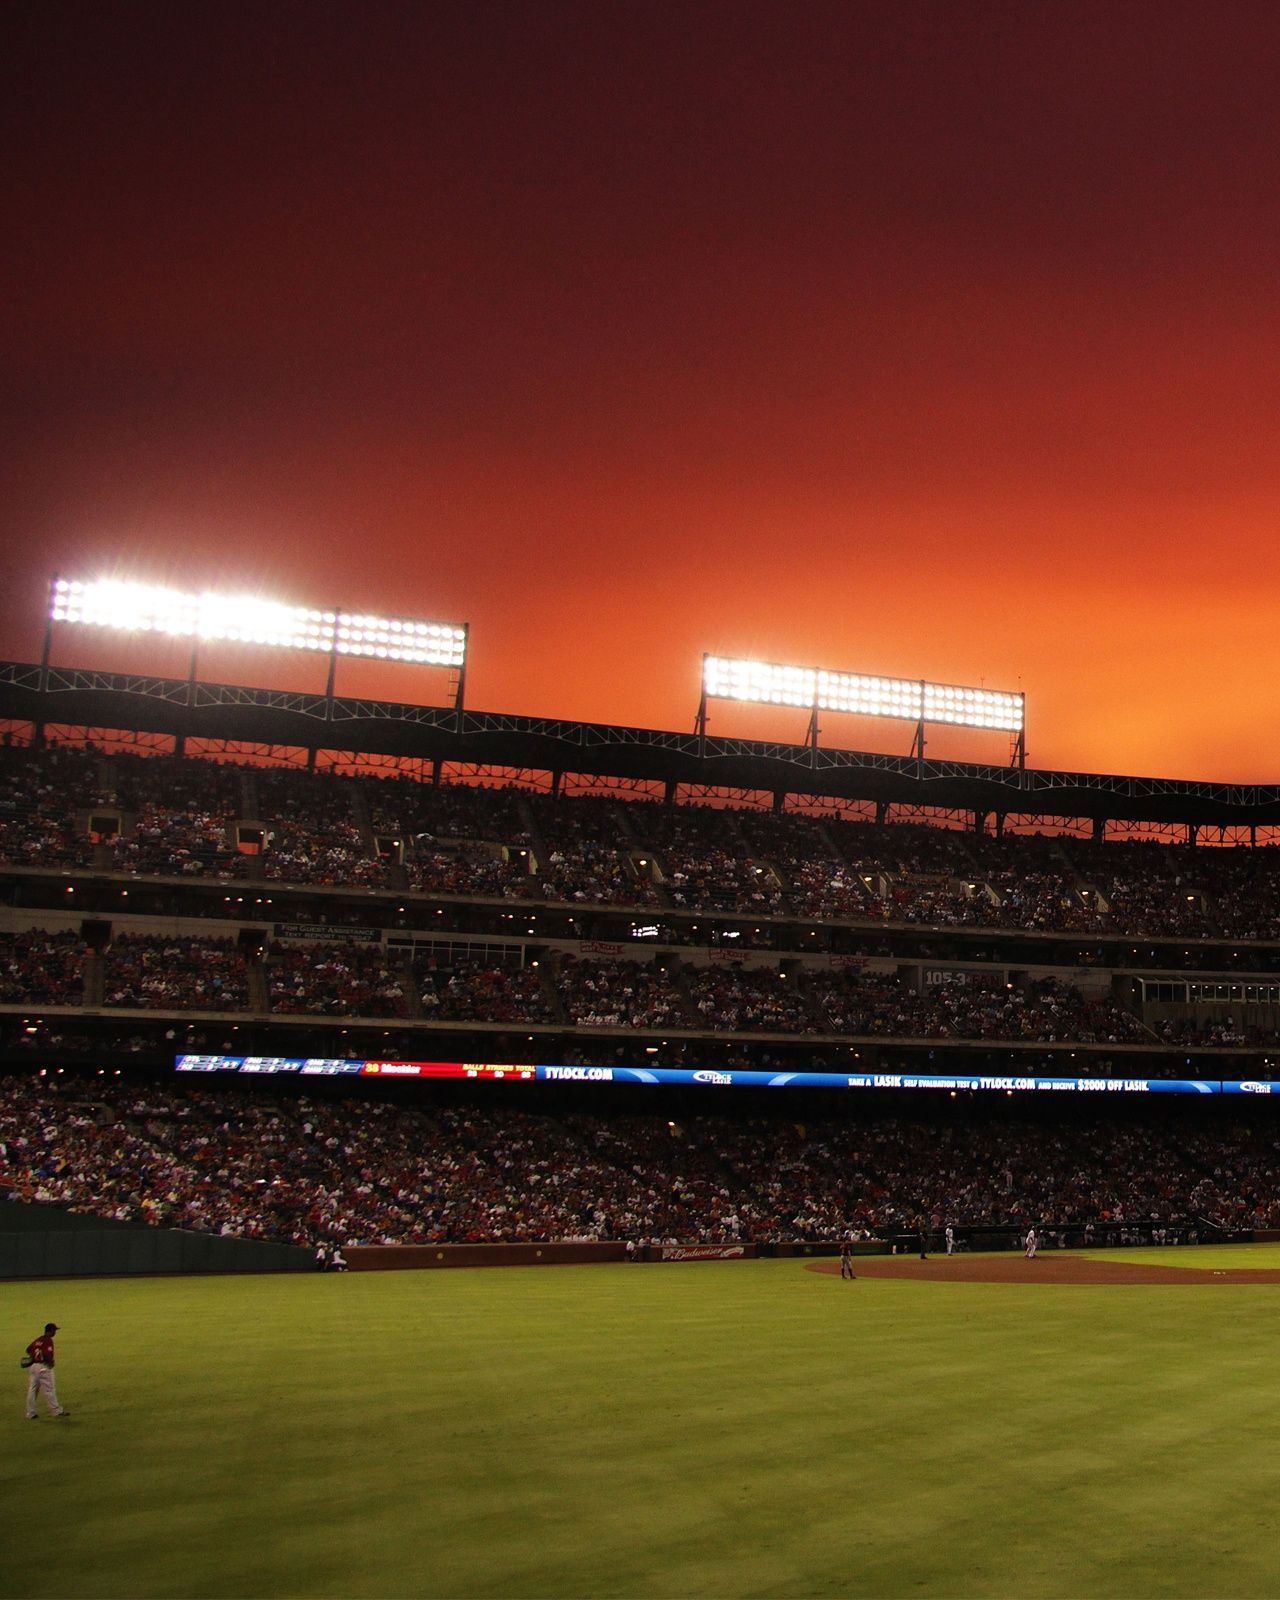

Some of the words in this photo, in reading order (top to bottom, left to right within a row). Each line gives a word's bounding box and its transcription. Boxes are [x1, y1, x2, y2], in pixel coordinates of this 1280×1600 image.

[544, 1067, 614, 1081] TYLOCK.COM
[873, 1075, 902, 1088] LASIK
[980, 1078, 1036, 1090] TYLOCK.COM
[1077, 1079, 1106, 1092] $2000
[1107, 1080, 1123, 1091] OFF
[674, 1248, 723, 1260] Budweiser
